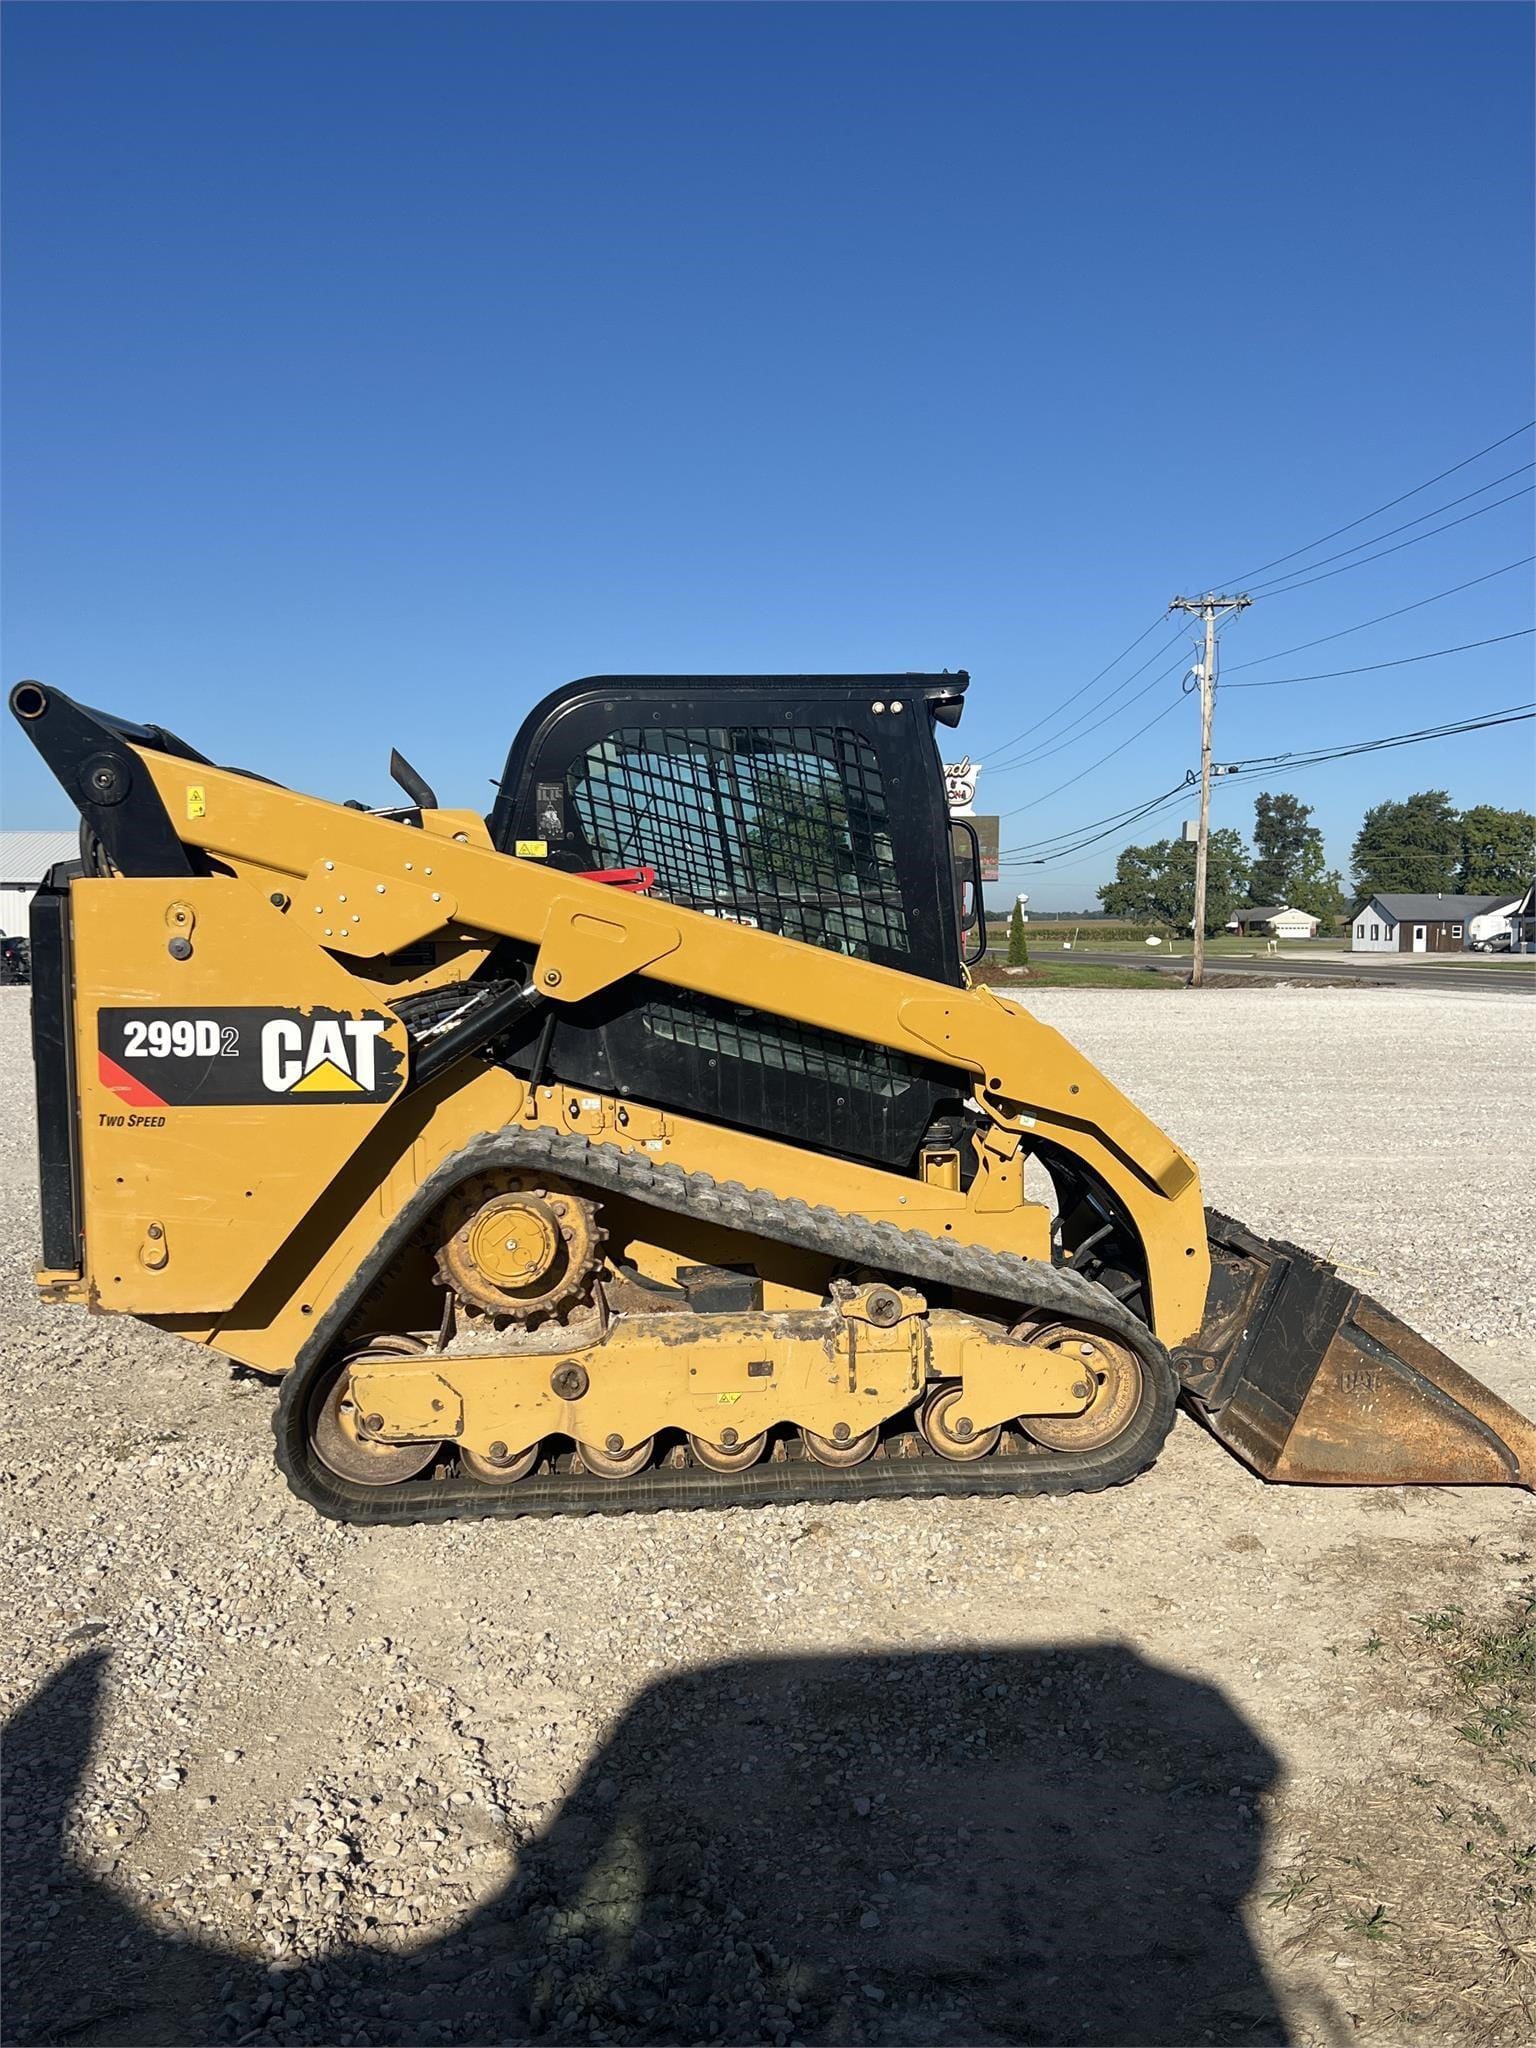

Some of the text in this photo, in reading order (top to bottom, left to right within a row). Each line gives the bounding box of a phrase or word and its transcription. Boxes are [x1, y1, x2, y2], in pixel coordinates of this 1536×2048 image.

[123, 1020, 240, 1058] 299D2
[261, 1019, 385, 1093] CAT
[1341, 1369, 1378, 1394] CAT
